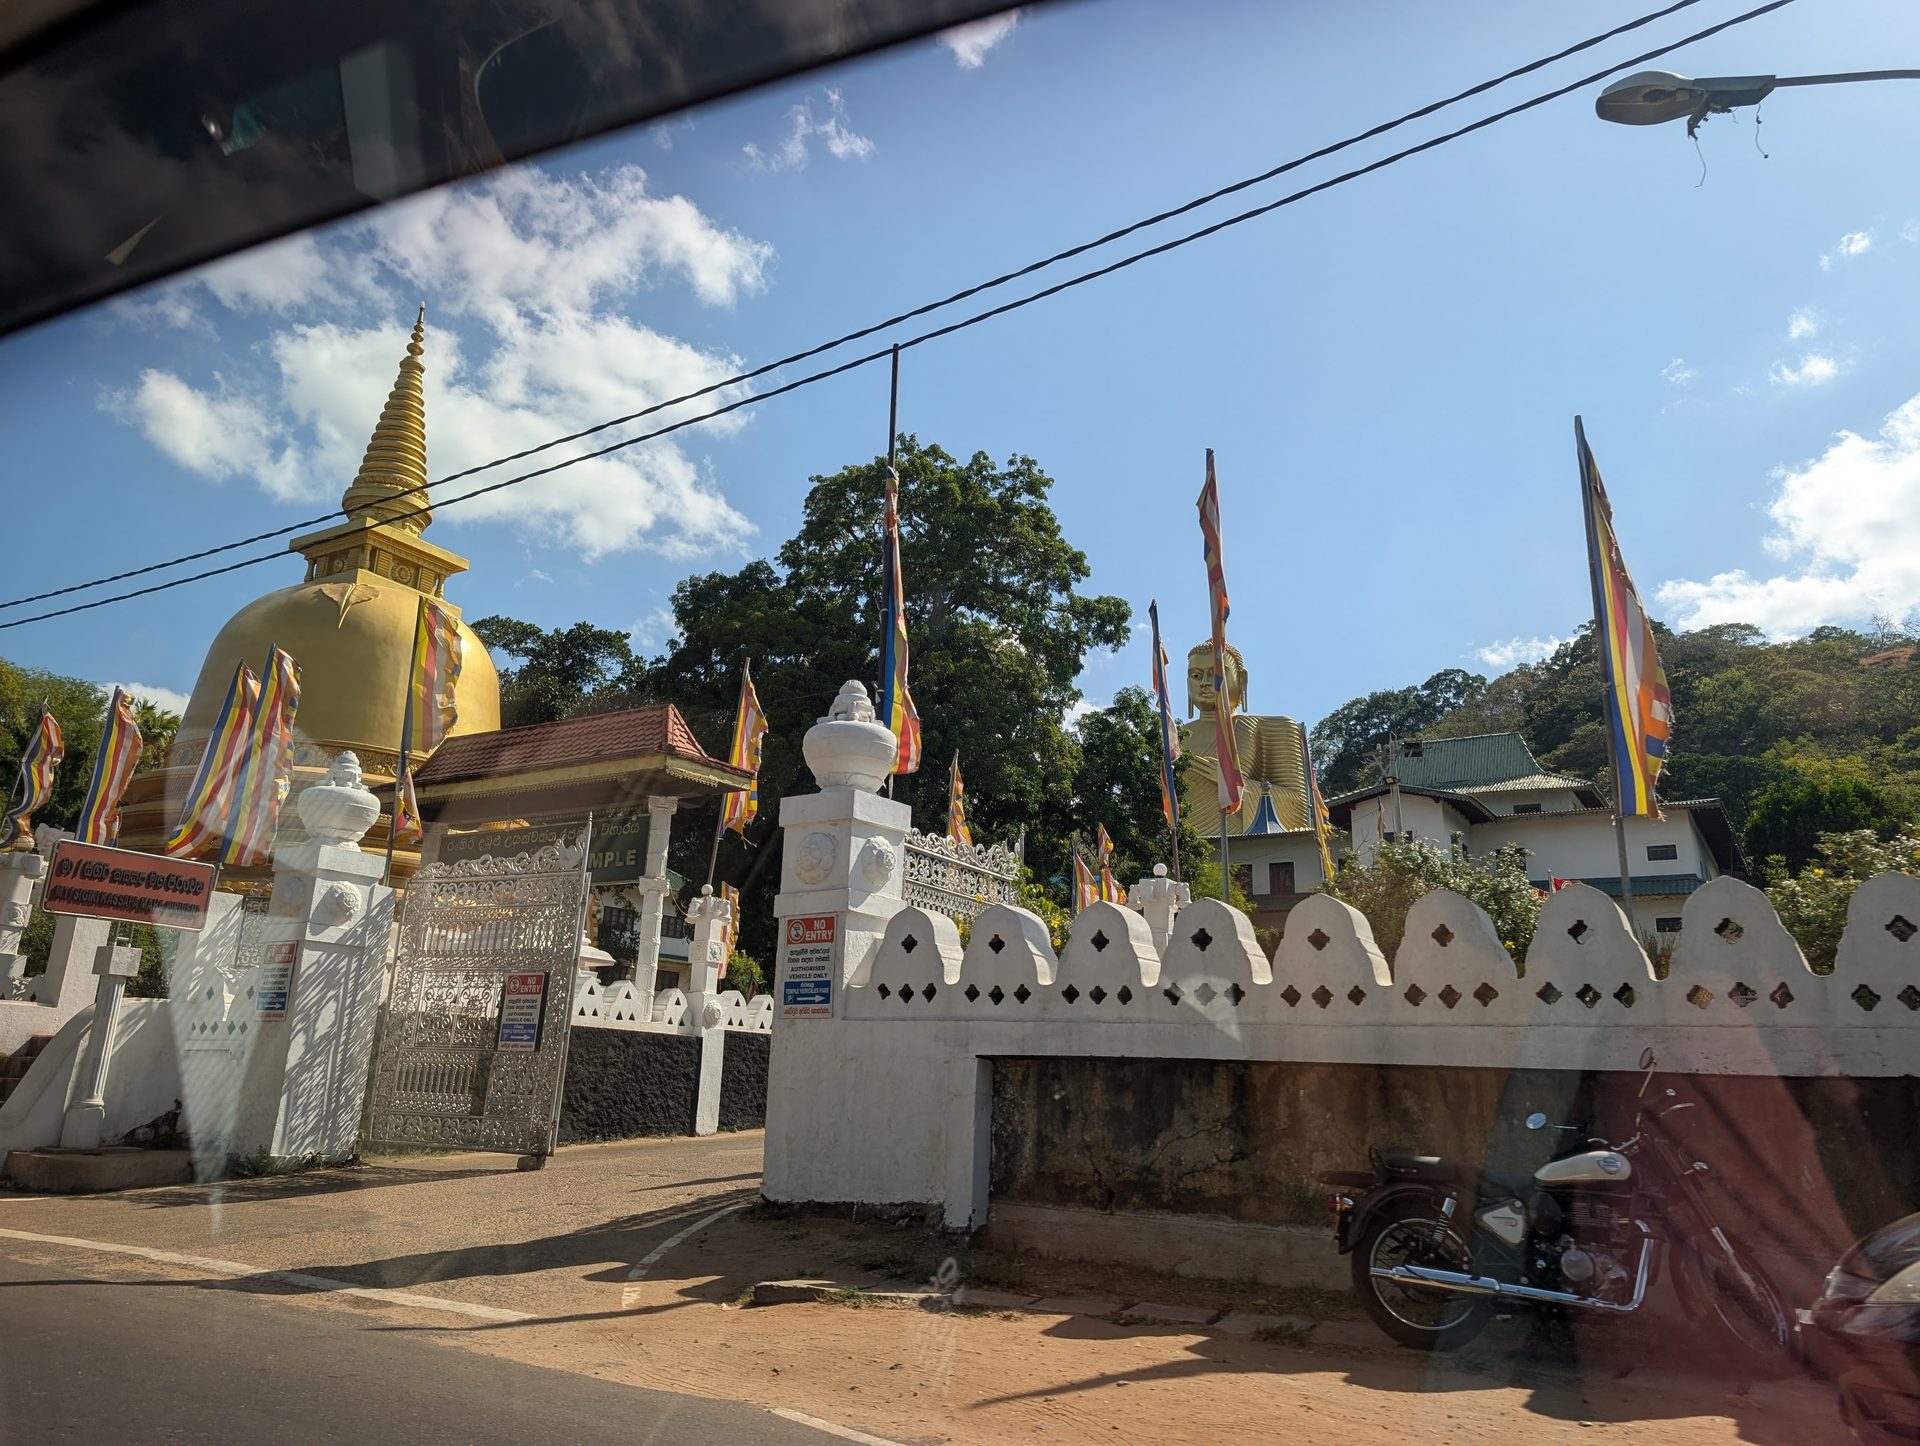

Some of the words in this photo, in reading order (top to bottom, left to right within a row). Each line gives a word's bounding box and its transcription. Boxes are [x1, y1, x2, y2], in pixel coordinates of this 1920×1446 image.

[587, 849, 638, 869] MPLE
[814, 919, 826, 930] NO
[806, 930, 833, 941] ENTRY
